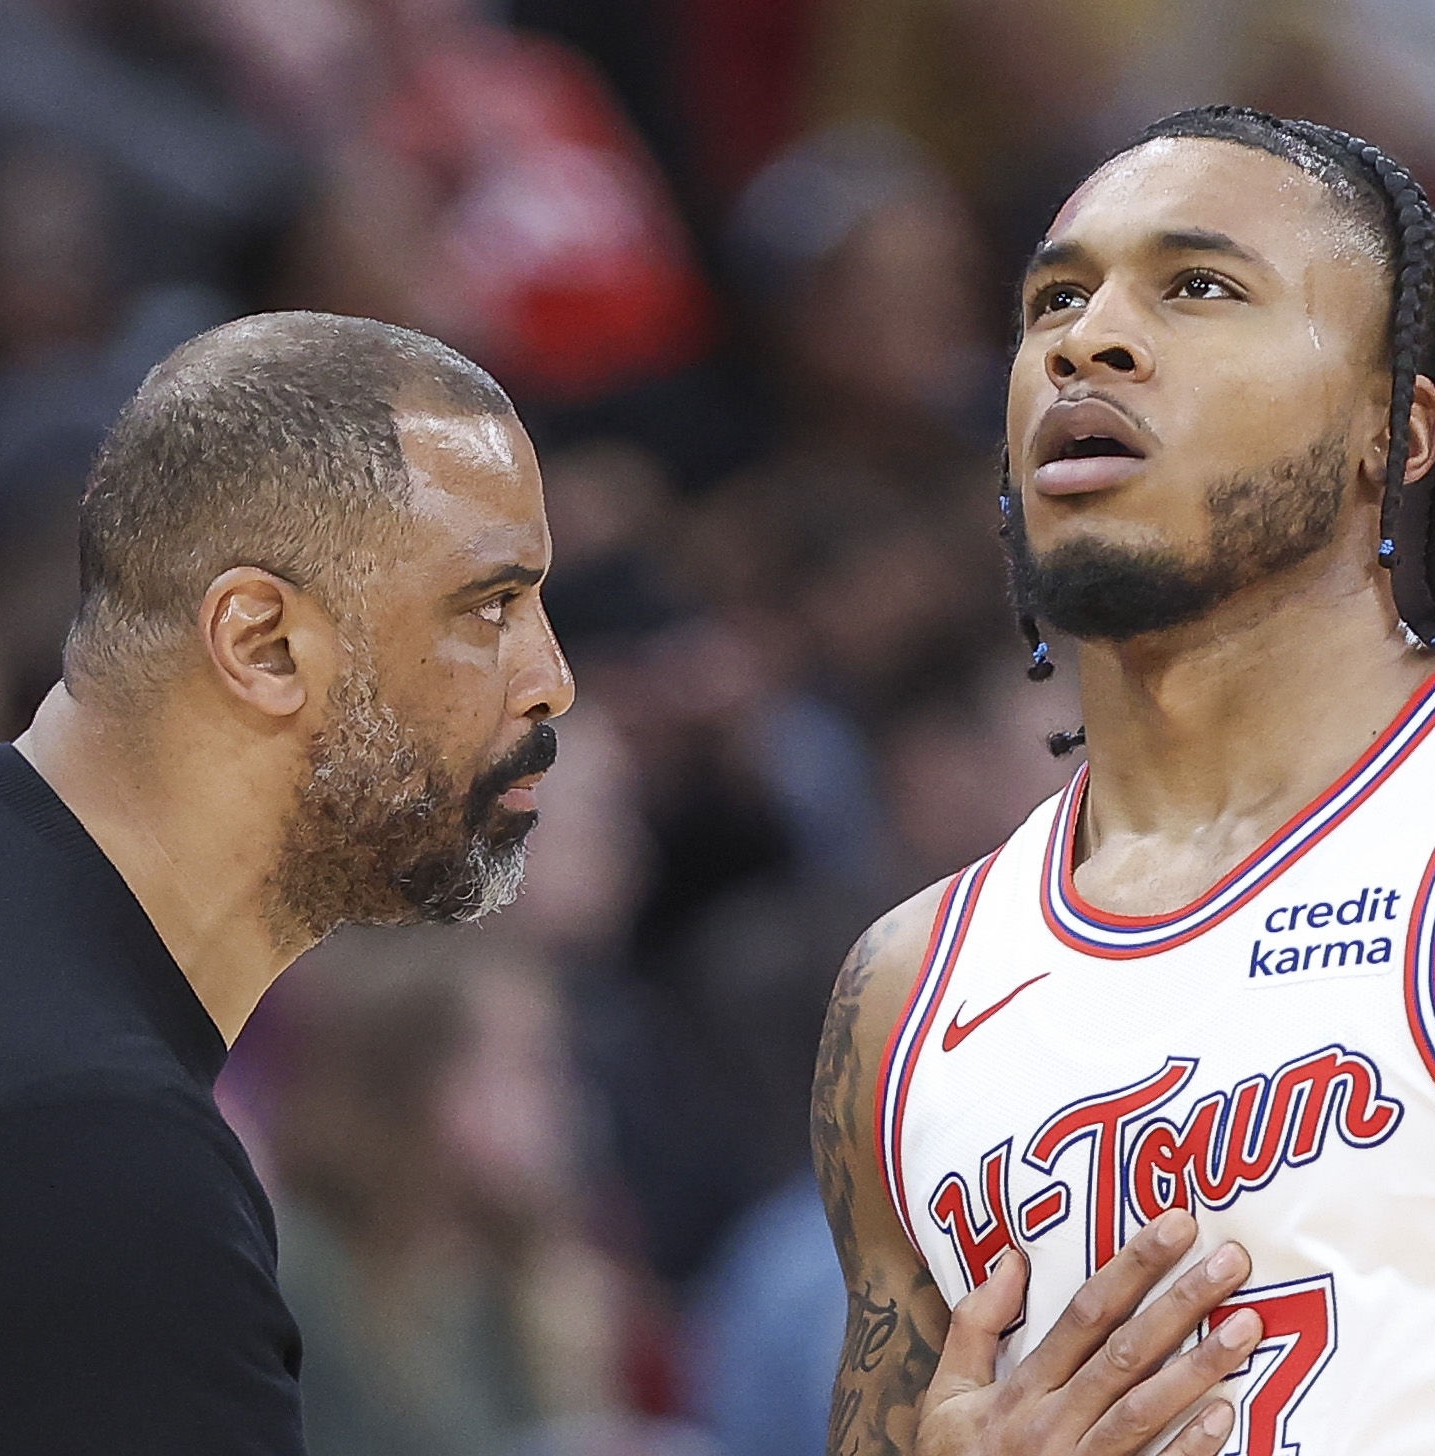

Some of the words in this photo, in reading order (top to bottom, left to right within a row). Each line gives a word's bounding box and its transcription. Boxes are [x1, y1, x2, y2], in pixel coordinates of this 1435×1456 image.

[1264, 886, 1402, 933] credit
[1248, 936, 1393, 978] karma
[928, 1042, 1405, 1338] H-Town
